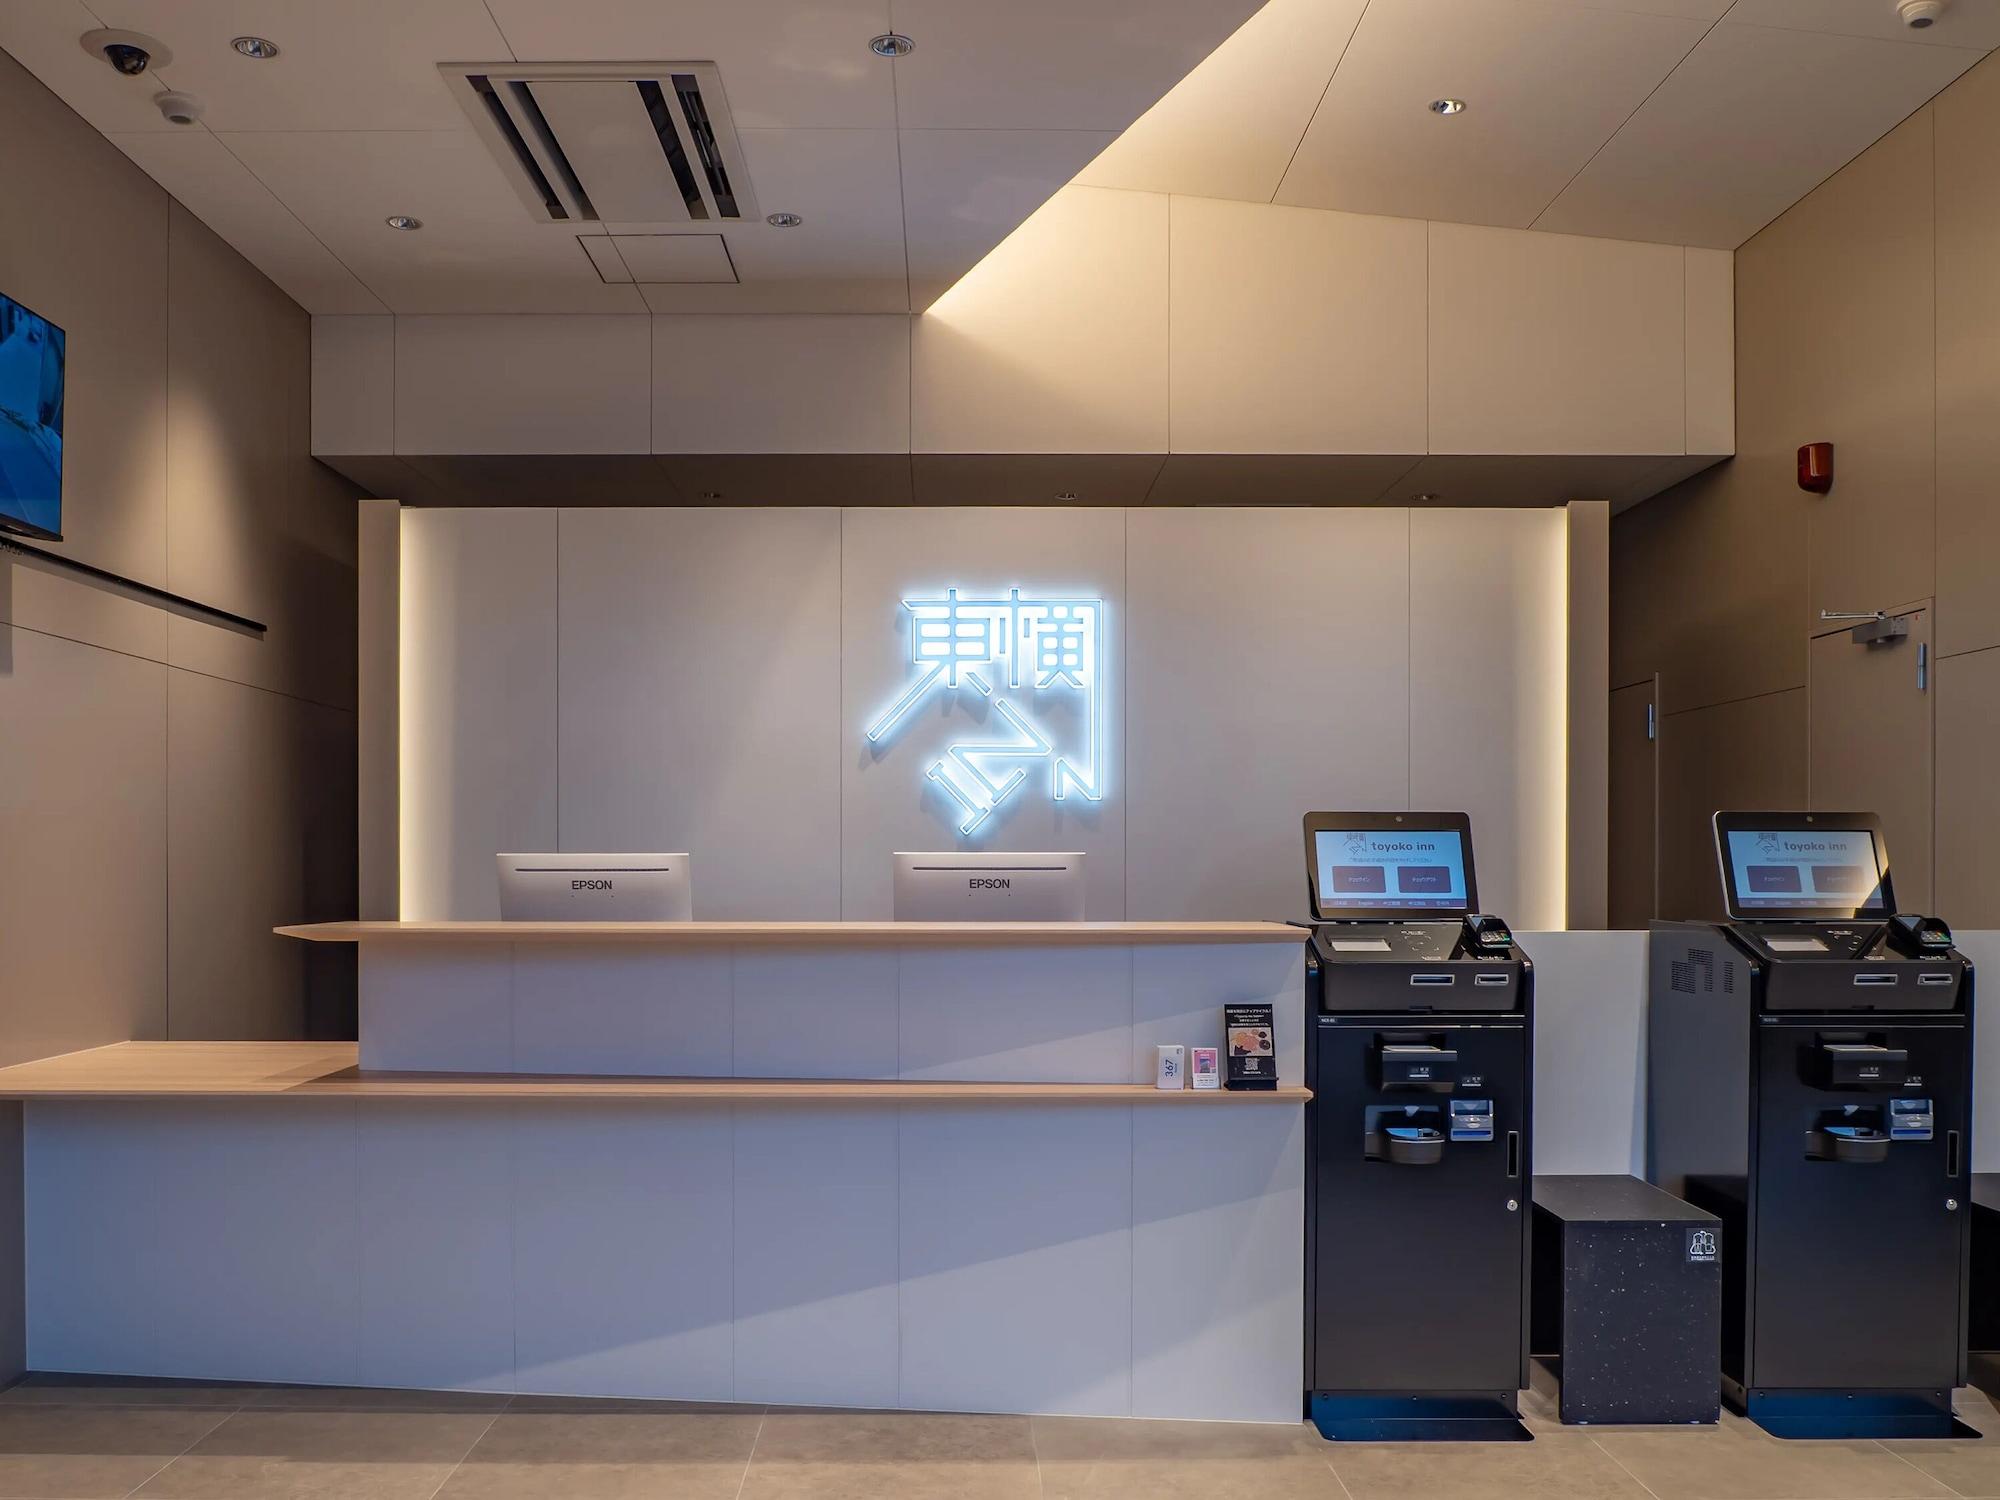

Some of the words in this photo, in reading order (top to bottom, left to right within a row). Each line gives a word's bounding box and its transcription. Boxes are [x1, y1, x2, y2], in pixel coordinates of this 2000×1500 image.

[1370, 841, 1413, 852] toyoko
[1416, 841, 1435, 851] inn
[1784, 841, 1825, 852] toyoko
[1829, 841, 1847, 851] inn
[571, 880, 613, 890] EPSON
[969, 879, 1010, 889] EPSON
